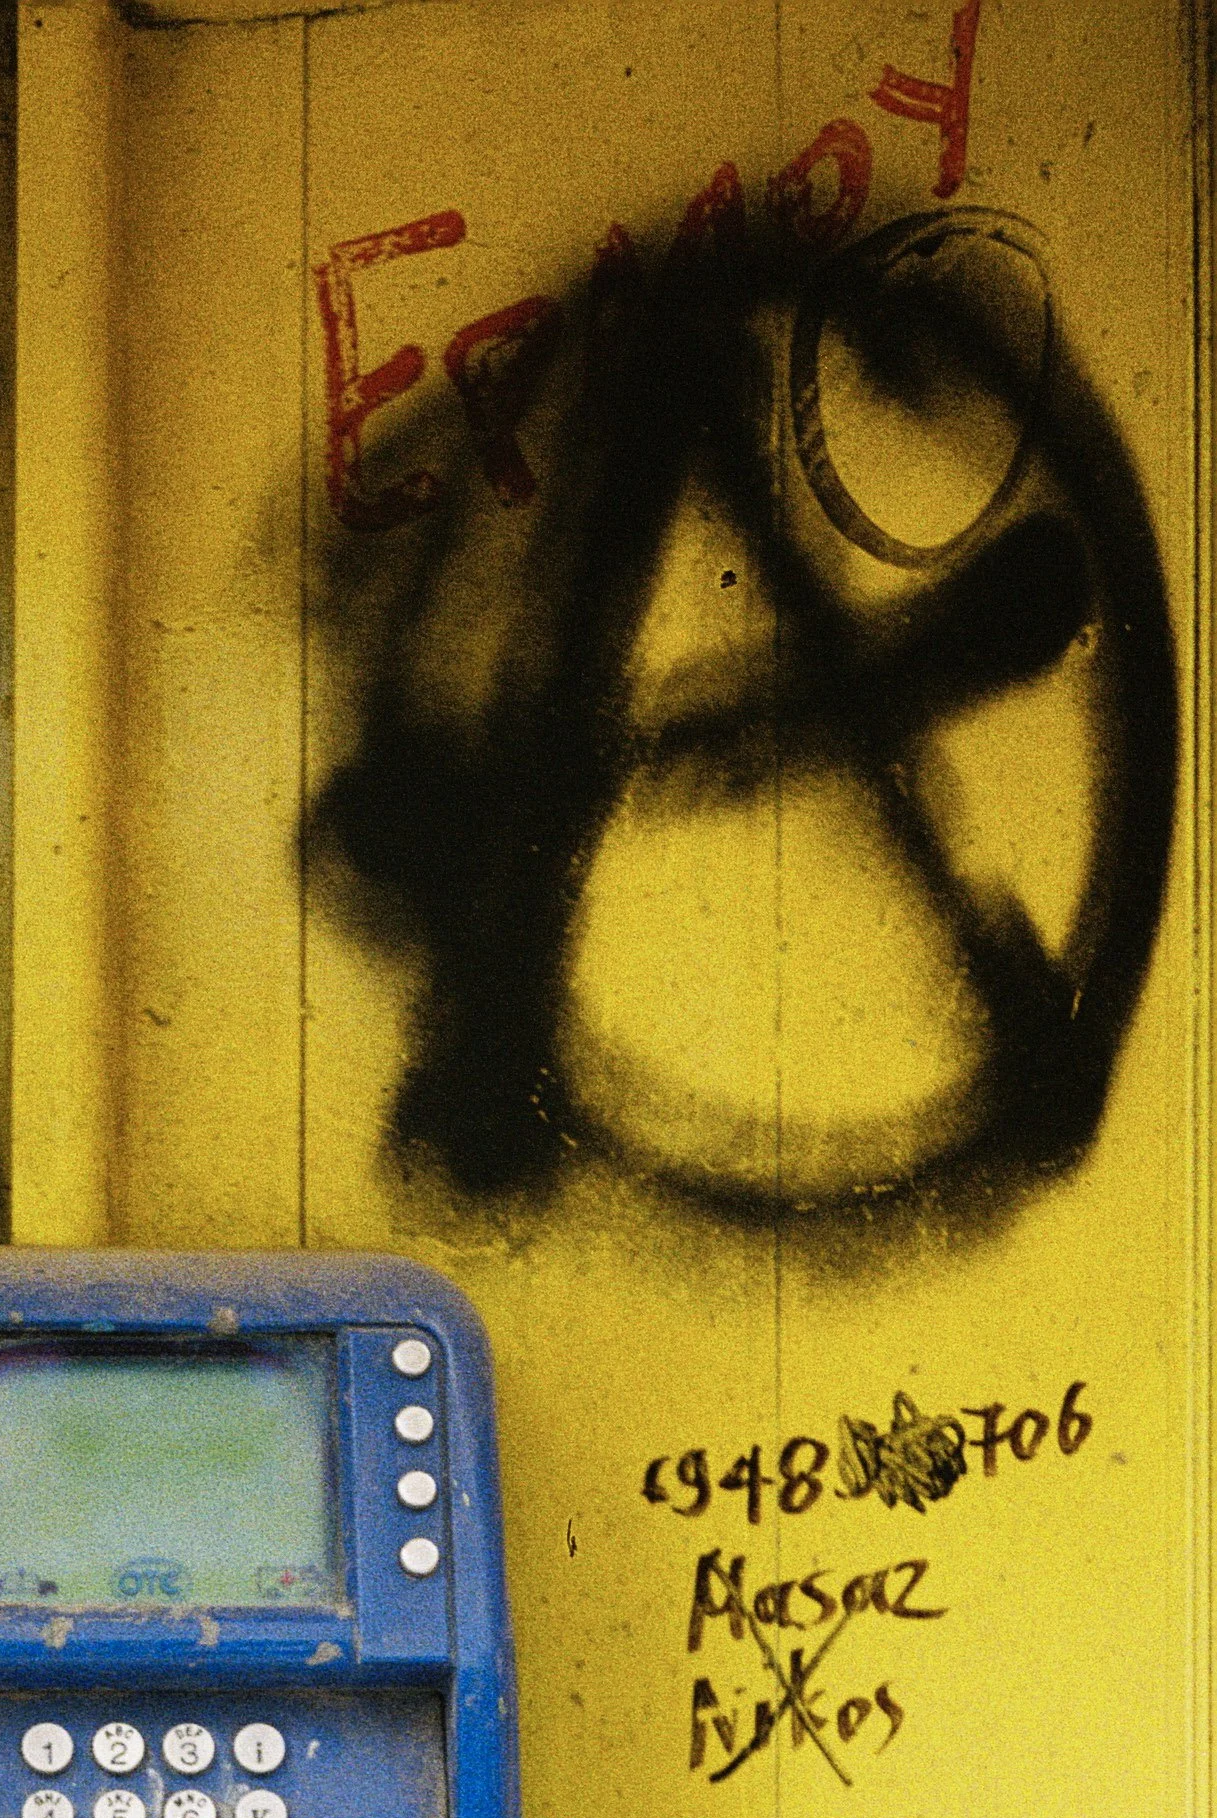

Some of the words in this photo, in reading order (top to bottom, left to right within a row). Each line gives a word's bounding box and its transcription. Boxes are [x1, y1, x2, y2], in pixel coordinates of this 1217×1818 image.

[40, 1740, 55, 1766] 1
[110, 1741, 127, 1766] 2
[180, 1742, 199, 1766] 3
